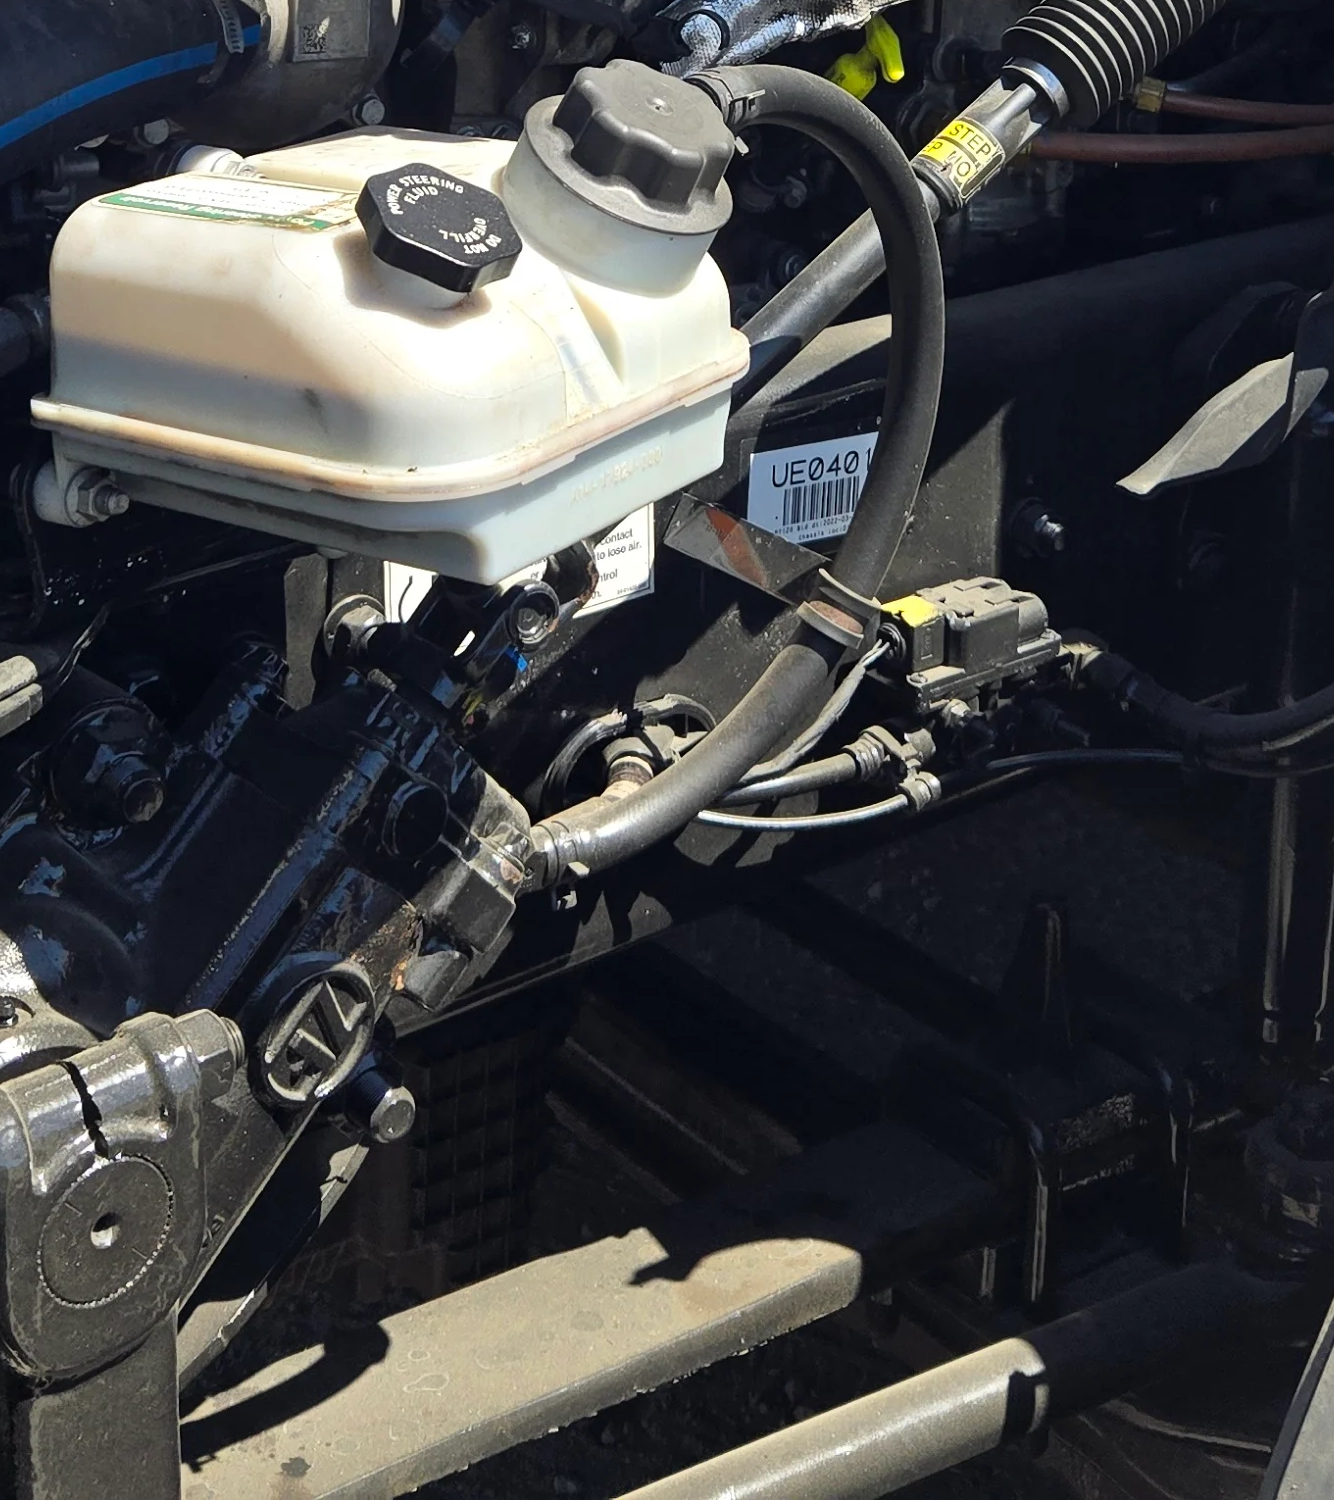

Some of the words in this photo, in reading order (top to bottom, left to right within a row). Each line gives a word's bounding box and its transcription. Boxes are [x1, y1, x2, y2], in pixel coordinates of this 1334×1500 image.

[949, 124, 991, 157] STEP
[387, 184, 403, 215] POWER
[399, 175, 463, 194] STEERING
[404, 186, 438, 204] FLUID
[439, 217, 487, 243] OVERFILL
[464, 244, 489, 255] NOT
[486, 234, 501, 248] DO
[608, 546, 626, 557] lose
[628, 541, 642, 551] air.
